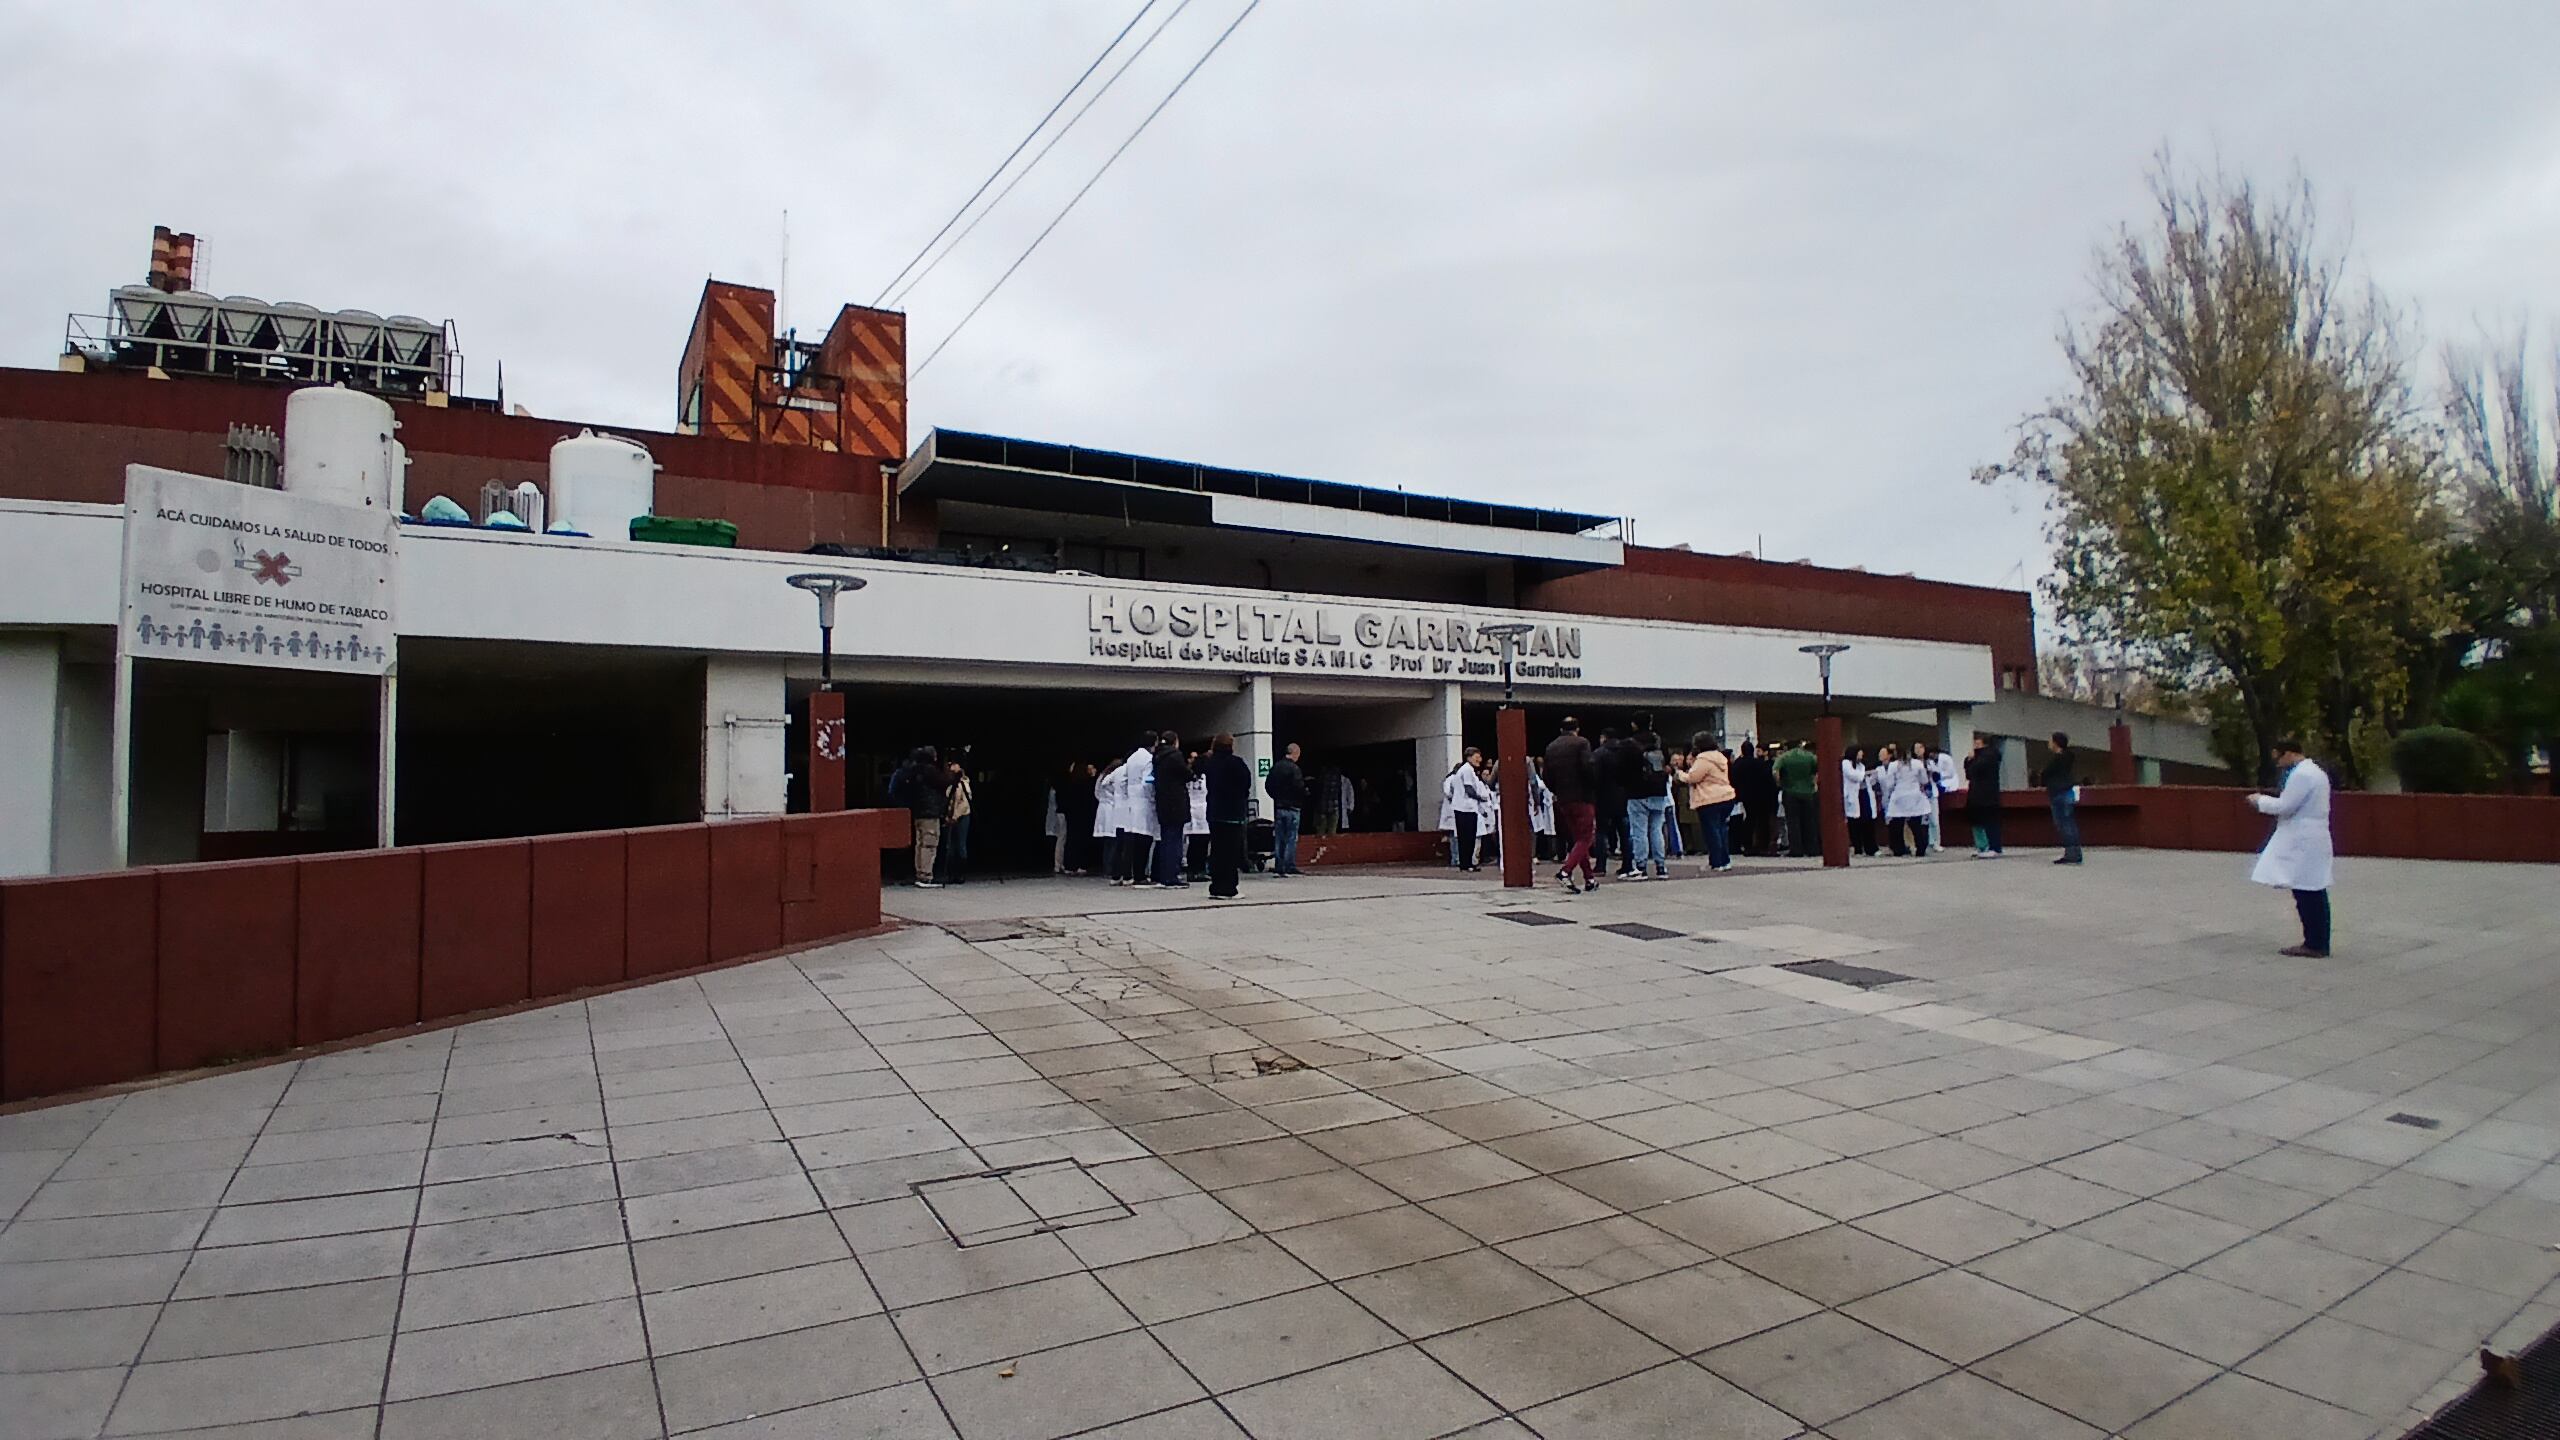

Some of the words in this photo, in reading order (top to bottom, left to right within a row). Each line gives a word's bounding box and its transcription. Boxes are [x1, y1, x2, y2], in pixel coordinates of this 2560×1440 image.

[189, 513, 261, 534] CUIDAMOS
[264, 525, 281, 538] LA
[284, 528, 326, 544] SALUD
[328, 535, 345, 547] DE
[347, 538, 389, 554] TODOS
[140, 582, 210, 602] HOSPITAL
[213, 591, 251, 607] LIBRE
[253, 595, 272, 608] DE
[274, 598, 316, 613] HUMO
[319, 603, 336, 615] DE
[339, 605, 389, 621] TABACO
[1088, 594, 1342, 646] HOSPITAL
[1089, 636, 1173, 662] Hospital
[1179, 642, 1204, 661] de
[1458, 658, 1496, 676] Juan
[1515, 661, 1582, 680] Garrahan
